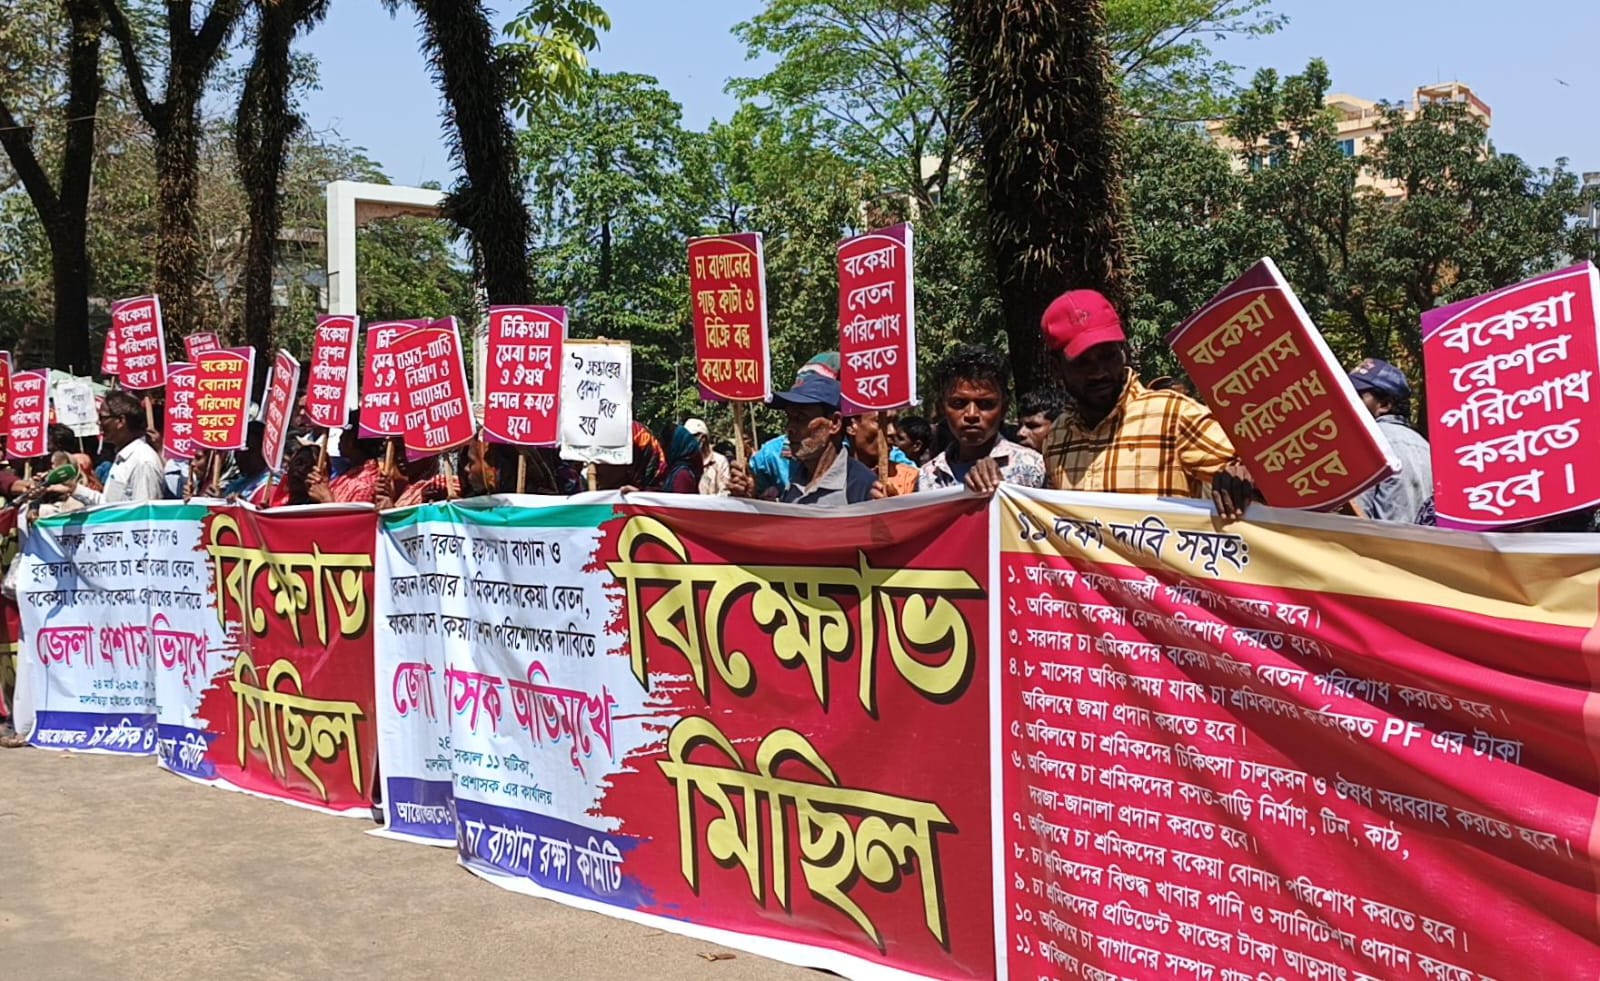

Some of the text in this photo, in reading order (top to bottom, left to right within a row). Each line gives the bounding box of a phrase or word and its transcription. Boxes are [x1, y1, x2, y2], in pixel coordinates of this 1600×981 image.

[695, 252, 751, 280] চা বাগানের
[844, 244, 897, 278] বকেয়া
[118, 306, 152, 322] বকেয়া
[697, 284, 754, 316] গাছ কাটা ও
[848, 281, 895, 310] বেতন
[500, 315, 550, 338] চিকিৎসা
[704, 317, 750, 349] বিক্রি বন্ধ
[843, 314, 901, 344] পরিশোধ
[1187, 293, 1276, 366] বকেয়া
[1438, 290, 1576, 354] বকেয়া
[201, 360, 243, 373] বকেয়া
[496, 345, 553, 370] সেবা চালু
[500, 370, 509, 385] ও
[701, 358, 732, 384] করতে
[846, 345, 899, 372] করতে
[1210, 330, 1301, 407] বোনাস
[1449, 333, 1572, 392] রেশন
[197, 394, 241, 411] পরিশোধ
[198, 379, 242, 391] বোনাস
[488, 392, 556, 417] প্রদান করতে
[856, 374, 890, 399] হবে
[1234, 368, 1328, 442] পরিশোধ
[1440, 369, 1593, 435] পরিশোধ
[197, 414, 236, 427] করতে
[203, 430, 229, 442] হবে
[1255, 409, 1339, 473] করতে
[1454, 418, 1582, 473] করতে
[1286, 449, 1349, 497] হবে
[511, 541, 545, 566] বাগান
[549, 544, 561, 564] ও
[1018, 512, 1047, 541] ১১
[1053, 517, 1102, 548] দফা
[1110, 517, 1169, 559] দাবি
[206, 513, 374, 649] বিক্ষোভ
[1024, 562, 1078, 587] অবিলম্বে
[556, 622, 596, 659] দাবিতে
[606, 515, 986, 720] বিক্ষোভ
[1026, 594, 1079, 620] অবিলম্বে
[1082, 603, 1128, 626] বকেয়া
[1232, 628, 1285, 649] করতে
[37, 622, 94, 666] জেলা
[1027, 629, 1453, 710] সরদার চা শ্রমিকদের বকেয়া বেতন পরিশোধ করতে
[229, 650, 367, 803] মিছিল
[508, 660, 618, 783] অভিমুখে
[1022, 687, 1200, 735] অবিলম্বে জমা প্রদান করতে
[1024, 660, 1035, 677] ৮
[1040, 662, 1084, 684] মাসের
[1088, 664, 1128, 689] অধিক
[1130, 675, 1163, 698] সময়
[1168, 679, 1206, 703] যাবৎ
[1210, 685, 1226, 706] চা
[1231, 686, 1300, 719] শ্রমিকদের
[1382, 718, 1424, 746] PF
[1431, 731, 1466, 755] এর
[1473, 726, 1524, 764] টাকা
[454, 748, 483, 768] সকাল
[487, 755, 500, 769] ১১
[1026, 719, 1513, 839] অবিলম্বে চা শ্রমিকদের চিকিৎসা চালুকরন ও ঔষধ সরবরাহ করতে
[1027, 751, 1076, 780] অবিলম্বে
[1080, 765, 1096, 785] চা
[1100, 764, 1174, 799] শ্রমিকদের
[460, 775, 500, 791] প্রশাসক
[503, 782, 518, 797] এর
[657, 716, 959, 954] মিছিল
[1028, 785, 1215, 840] দরজা-জানালা প্রদান করতে
[465, 819, 624, 893] চা বাগান রক্ষা কমিটি
[1028, 814, 1416, 932] অবিলম্বে চা শ্রমিকদের বকেয়া বোনাস পরিশোধ করতে
[1031, 846, 1413, 972] চা শ্রমিকদের বিশুদ্ধ খাবার পানি ও স্যানিটেশন প্রদান
[1032, 878, 1278, 966] চা শ্রমিকদের ফান্ডের টাকা
[1039, 910, 1079, 943] অবিলম্বে
[1081, 929, 1094, 951] চা
[1097, 935, 1161, 970] বাগানের
[1165, 952, 1215, 981] সম্পদ
